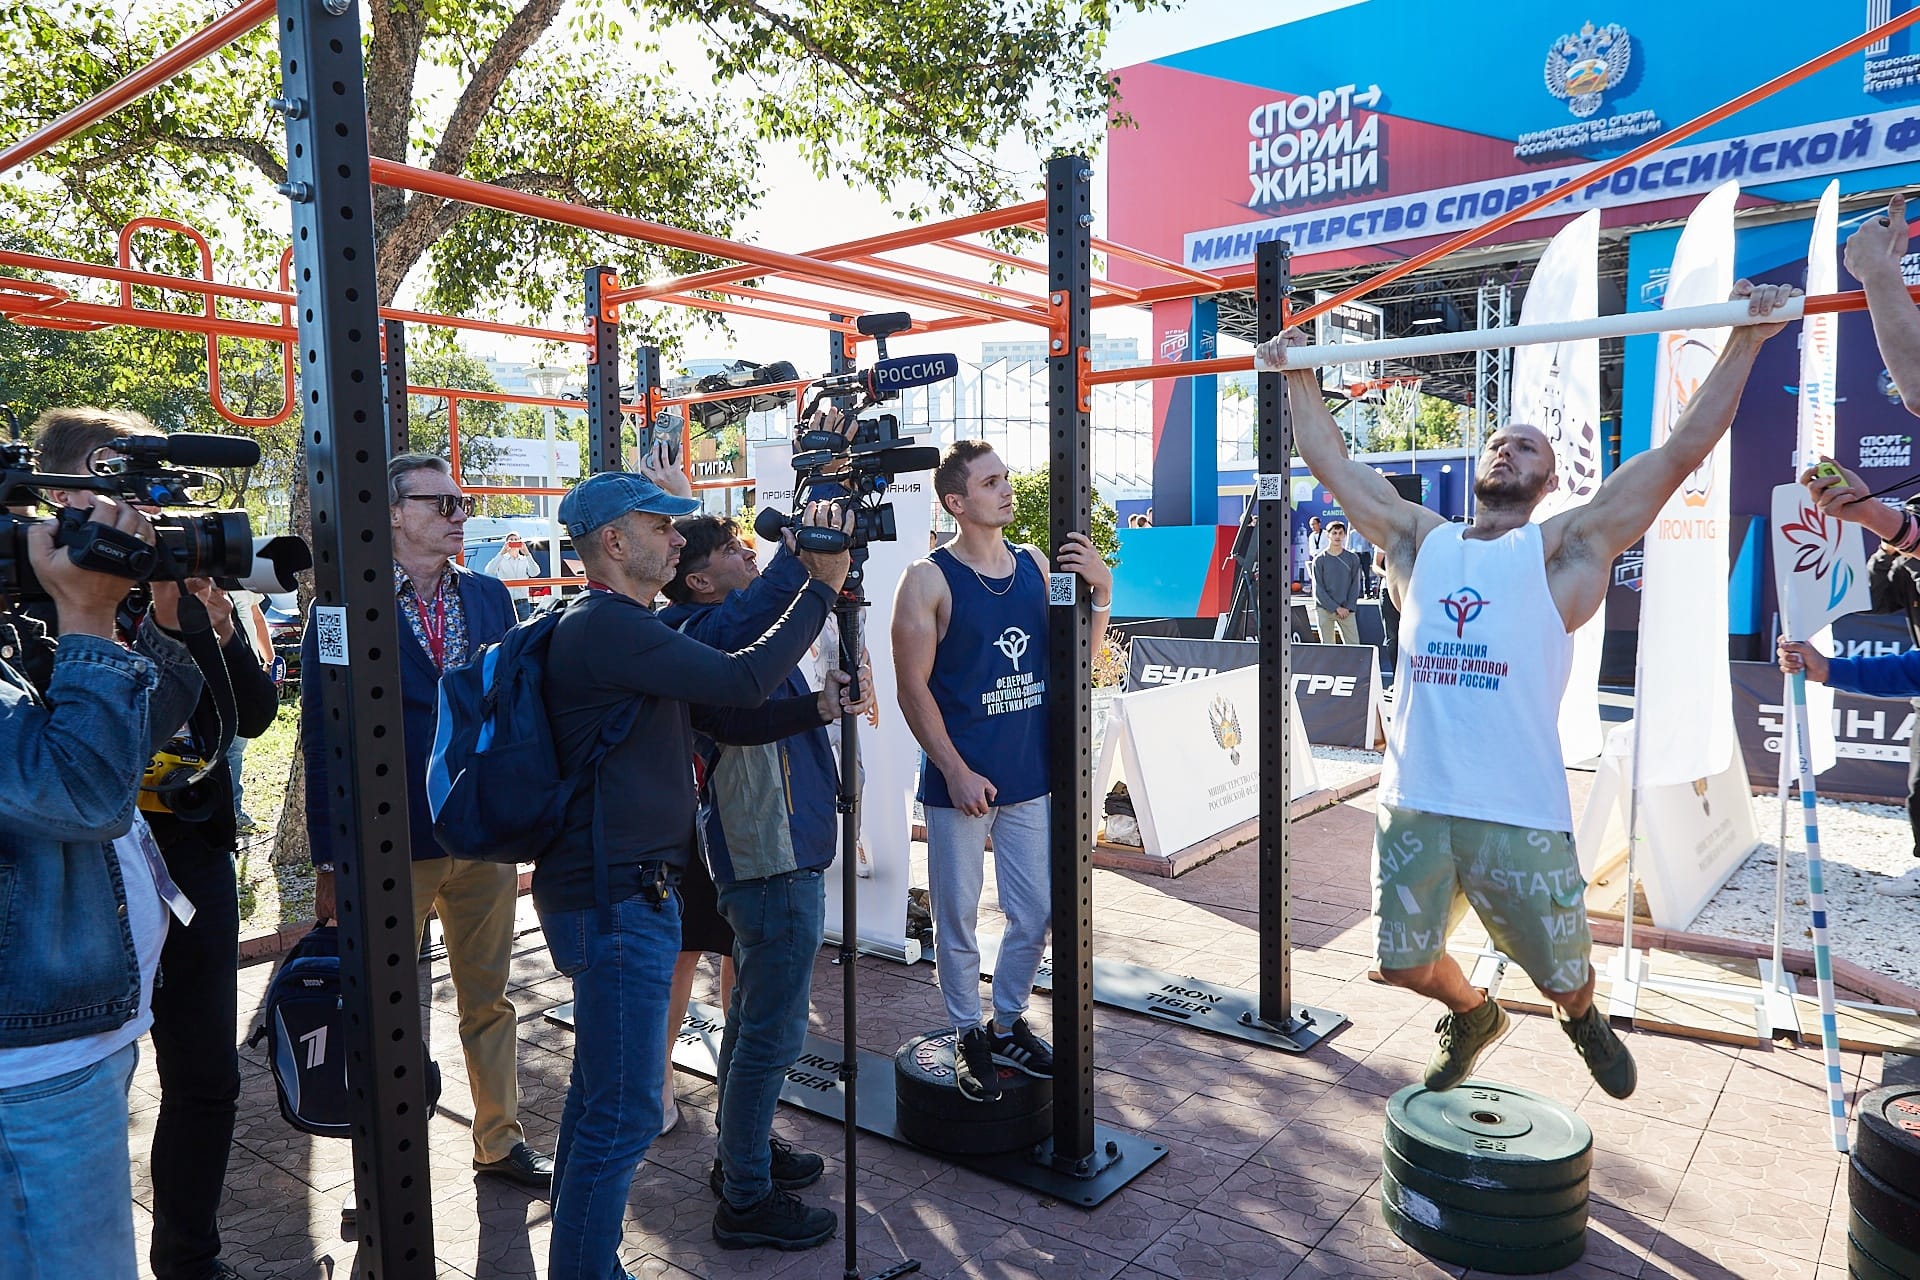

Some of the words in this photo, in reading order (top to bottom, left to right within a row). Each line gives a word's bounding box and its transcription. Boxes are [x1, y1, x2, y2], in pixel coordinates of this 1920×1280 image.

[1249, 84, 1355, 138] СПОРТ
[1513, 131, 1589, 157] РОССИЙСКОЙ
[1591, 120, 1662, 142] ФЕДЕРАЦИИ
[1518, 119, 1606, 146] МИНИСТЕРСТВО
[1609, 110, 1656, 127] СПОРТА
[1249, 114, 1378, 174] НОРМА
[1248, 150, 1378, 207] ЖИЗНИ
[1191, 201, 1428, 263] МИНИСТЕРСТВО
[878, 360, 946, 384] РОССИЯ
[1860, 435, 1903, 447] СПОРТ
[1860, 445, 1911, 457] НОРМА
[698, 460, 734, 476] ТИГРА
[1859, 456, 1911, 468] ЖИЗНИ
[811, 532, 833, 541] SONY
[1659, 519, 1693, 540] IRON
[1427, 641, 1488, 658] ФЕДЕРАЦИЯ
[1413, 669, 1457, 686] АТЛЕТИКИ
[1459, 674, 1500, 691] РОССИИ
[981, 679, 1046, 705] ВОЗДУШНО-СИЛОВОЙ
[987, 698, 1023, 716] АТЛЕТИКИ
[1146, 992, 1213, 1015] TIGER
[1160, 984, 1223, 1004] IRON
[786, 1066, 836, 1092] IGER
